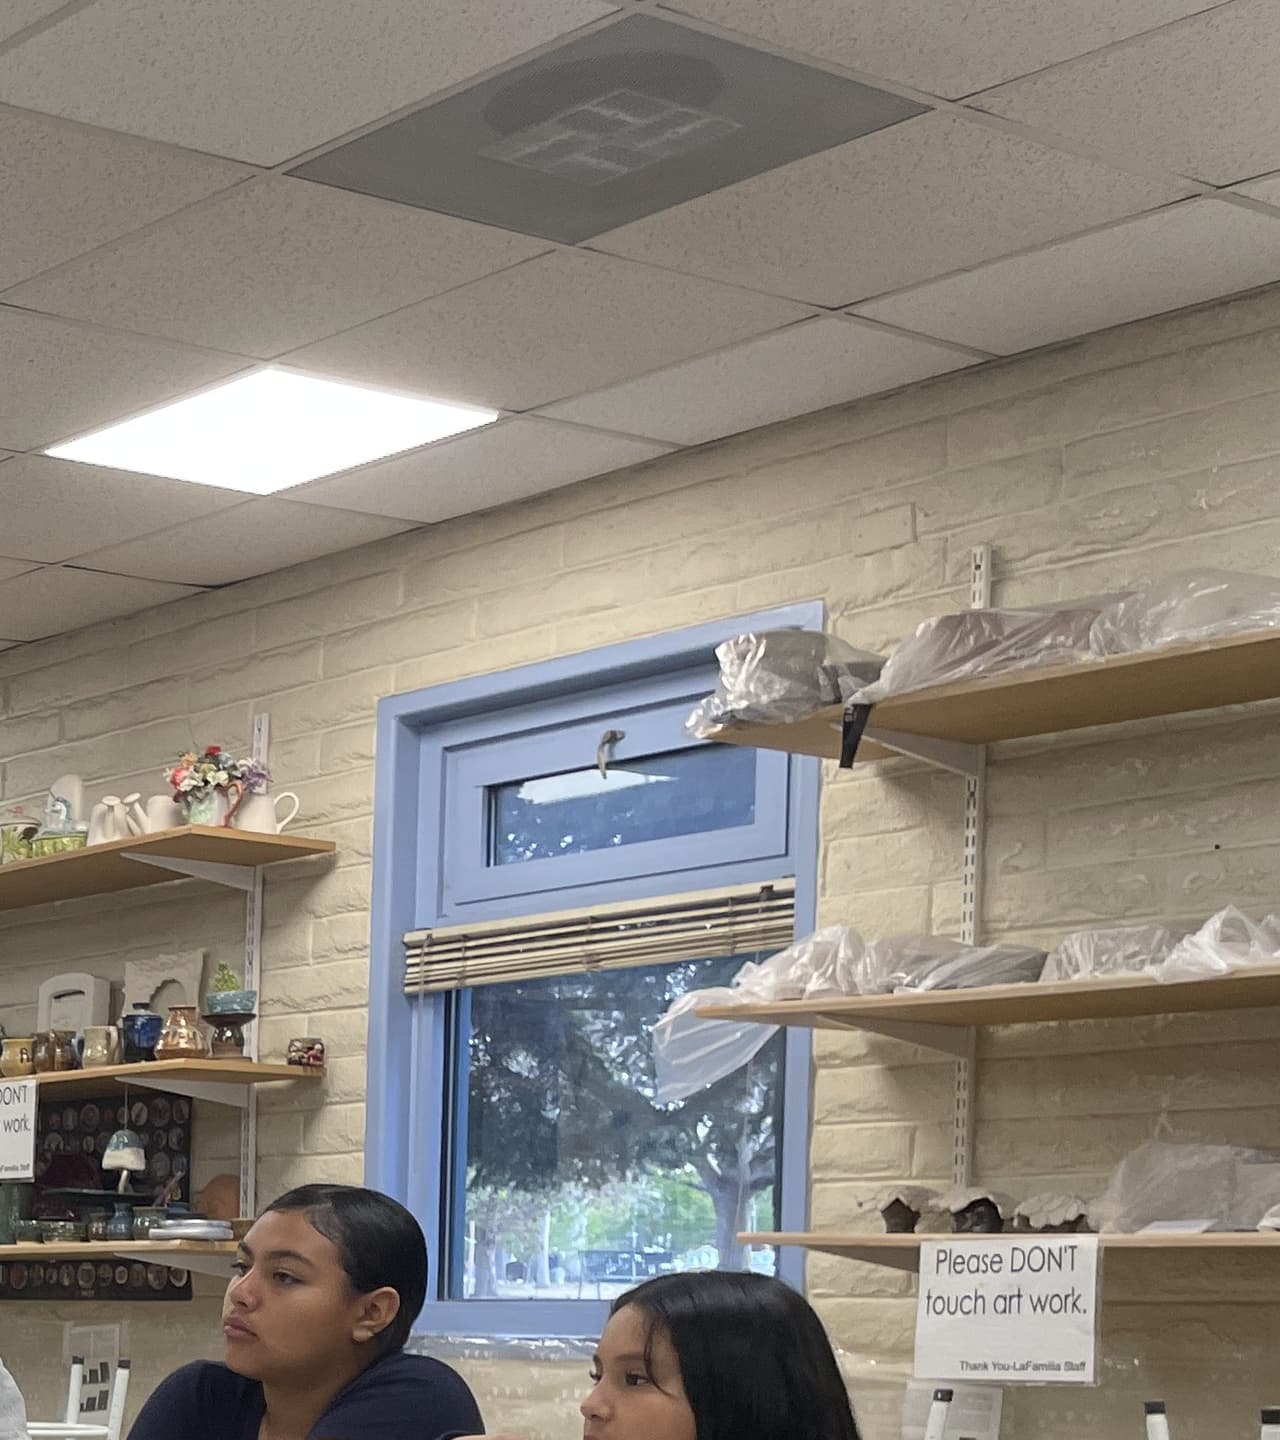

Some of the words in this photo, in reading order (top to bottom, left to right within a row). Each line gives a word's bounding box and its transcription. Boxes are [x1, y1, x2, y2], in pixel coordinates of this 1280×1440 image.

[936, 1248, 1003, 1275] Please
[1010, 1245, 1078, 1273] DON'T
[926, 1288, 986, 1317] touch
[993, 1287, 1023, 1315] art
[1029, 1286, 1088, 1315] work.
[960, 1360, 989, 1372] Thank
[1064, 1360, 1087, 1372] Staff
